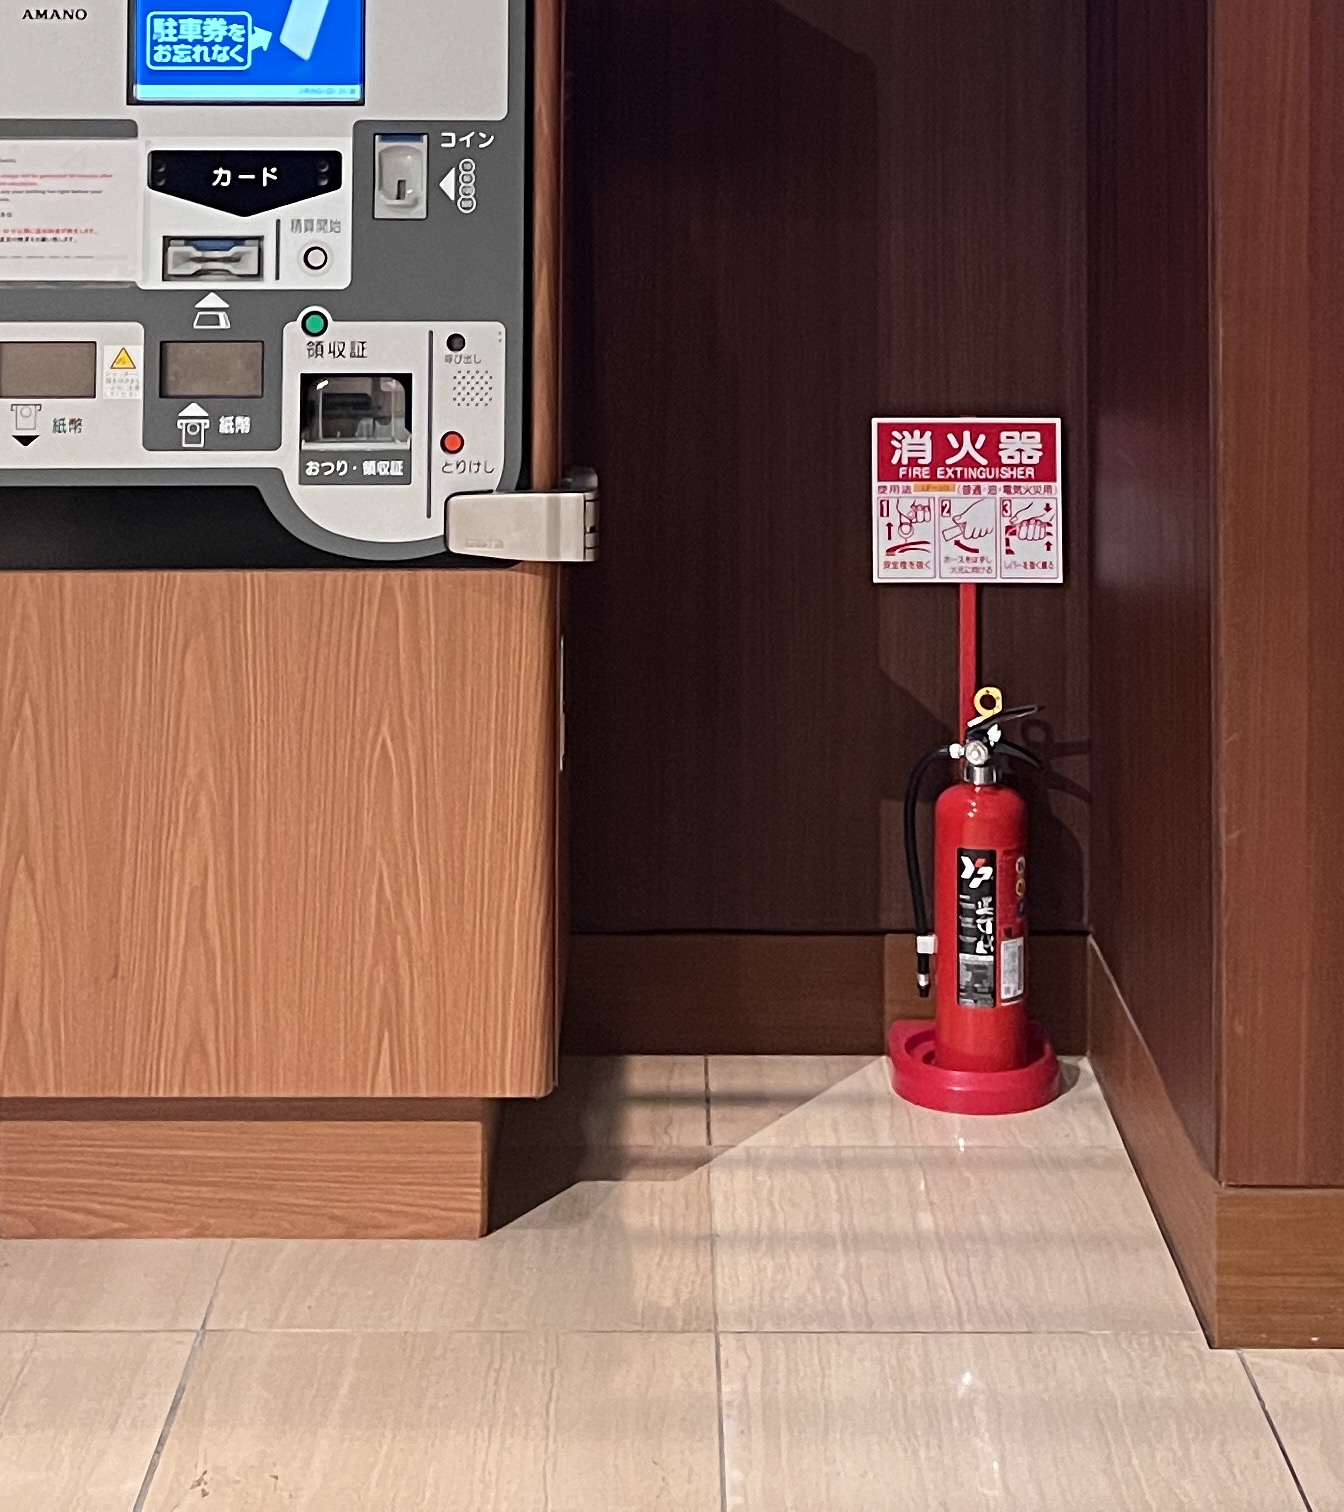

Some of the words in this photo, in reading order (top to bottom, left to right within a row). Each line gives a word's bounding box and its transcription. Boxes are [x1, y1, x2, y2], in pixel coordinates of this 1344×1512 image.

[21, 8, 88, 21] AMANO
[152, 17, 246, 43] 駐車券を
[152, 44, 245, 63] お忘れなく
[440, 131, 495, 148] コイン
[211, 167, 278, 187] カード
[306, 340, 368, 359] 領収証
[52, 417, 83, 434] 紙幣
[218, 415, 251, 434] 紙幣
[890, 429, 1044, 466] 消火器
[441, 459, 496, 474] とりけし
[898, 466, 931, 479] FIRE
[936, 466, 1035, 479] EXTINGUISHER
